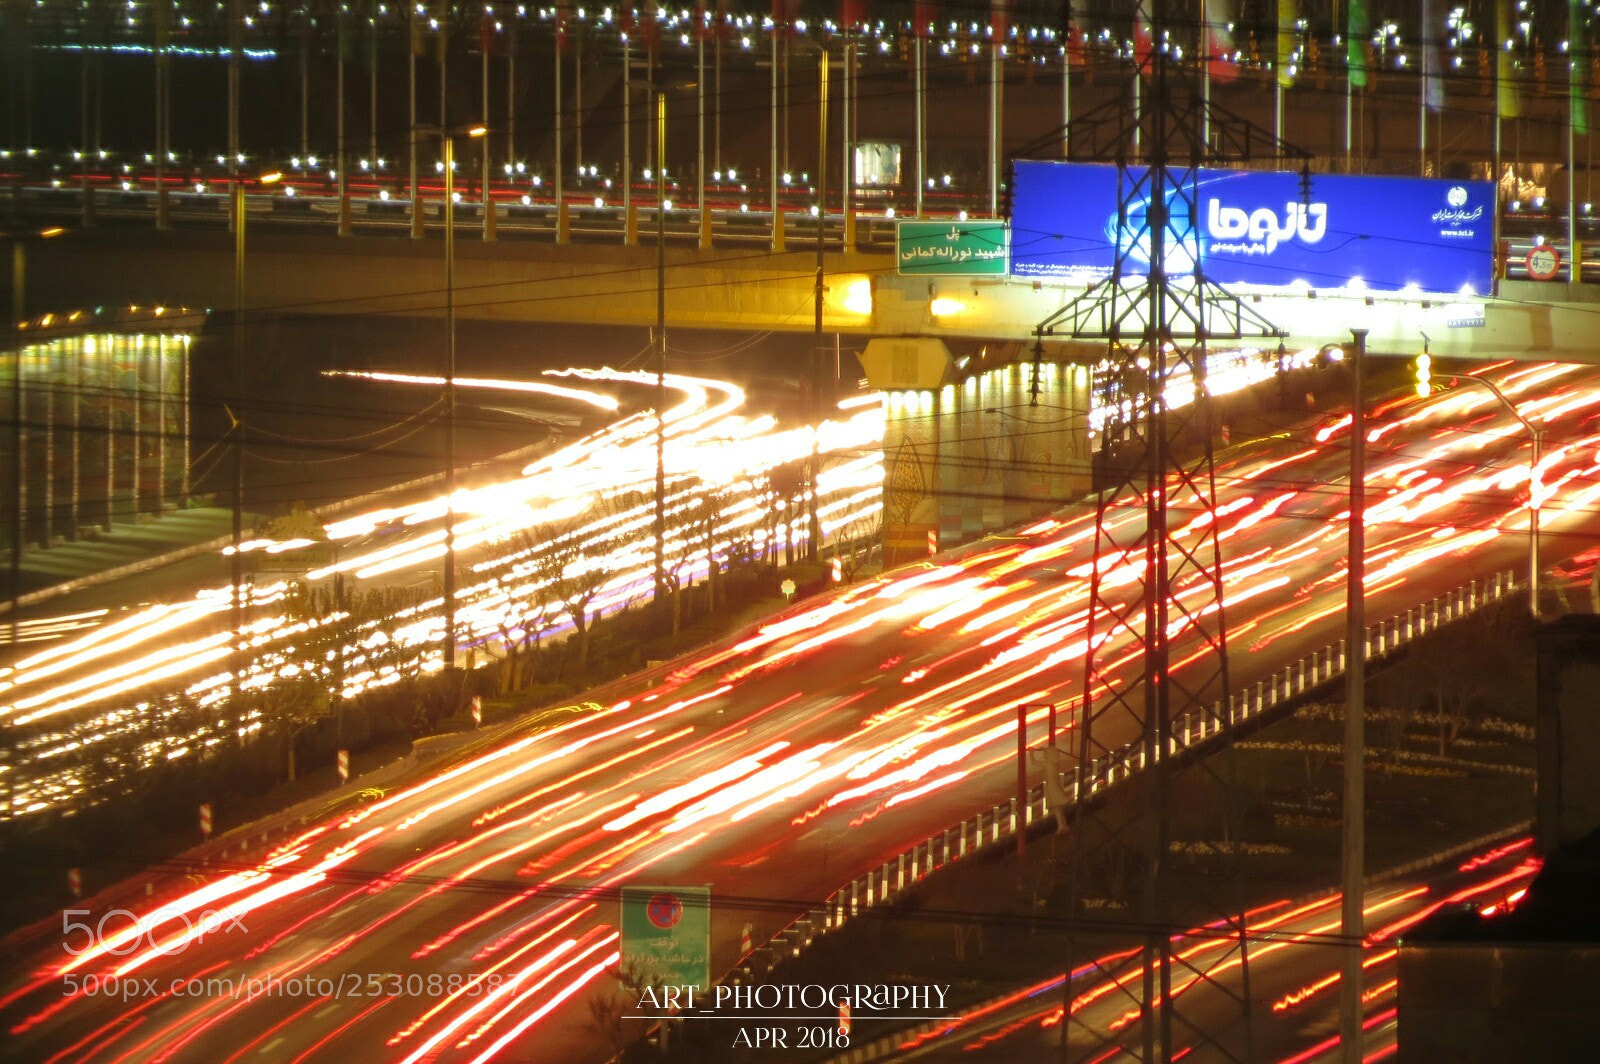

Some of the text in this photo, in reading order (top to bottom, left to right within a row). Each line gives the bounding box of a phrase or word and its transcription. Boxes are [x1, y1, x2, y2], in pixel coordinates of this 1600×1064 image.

[1432, 208, 1447, 221] ایران
[1463, 205, 1483, 221] شرکت
[946, 226, 960, 241] پل
[974, 245, 1005, 259] شهید
[650, 936, 679, 950] توقف
